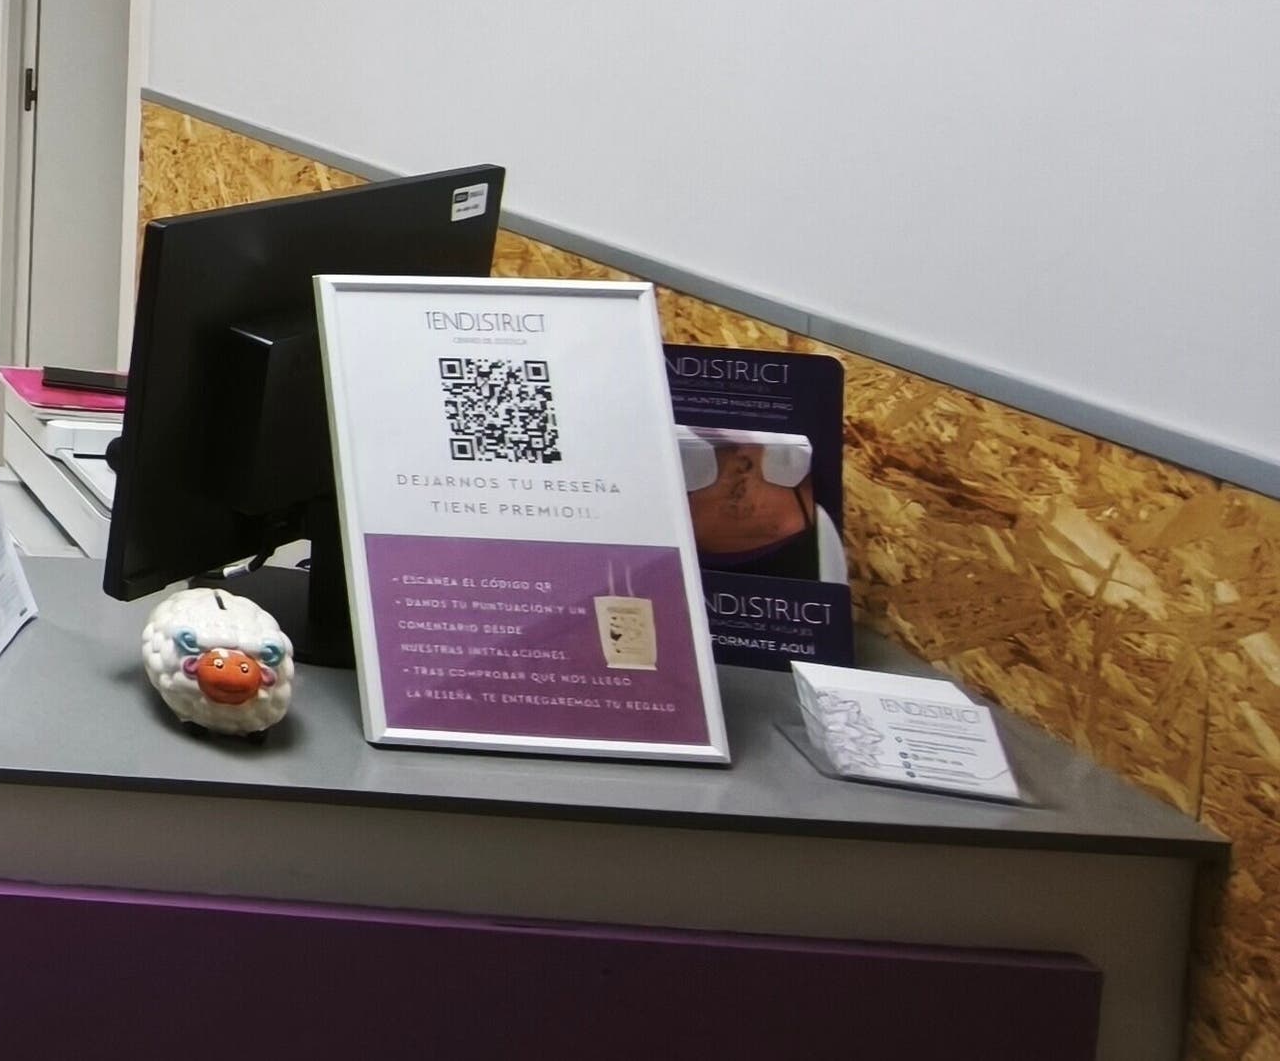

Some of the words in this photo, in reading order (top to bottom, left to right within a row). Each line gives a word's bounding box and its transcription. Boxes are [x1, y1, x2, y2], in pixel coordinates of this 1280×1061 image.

[424, 311, 545, 333] TENDISTRICT
[397, 474, 499, 489] DEJARNOS
[508, 478, 533, 490] TU
[544, 478, 621, 494] RESEÑA
[431, 501, 489, 514] TIENE
[403, 575, 458, 586] ESCANEA
[462, 578, 476, 587] EL
[481, 578, 530, 590] CÓDIGO
[535, 582, 552, 593] QR
[452, 600, 467, 609] TU
[398, 620, 479, 633] COMENTARIO
[483, 624, 523, 635] DESDE
[401, 643, 464, 655] NUESTRAS
[414, 666, 444, 676] TRAS
[449, 668, 525, 680] COMPROBAR
[531, 672, 556, 684] QUE
[561, 674, 587, 684] NOS
[406, 690, 420, 698] LA
[482, 693, 496, 702] TE
[502, 694, 600, 708] ENTREGAREMOS
[606, 699, 621, 709] TU
[626, 701, 676, 712] REGALO
